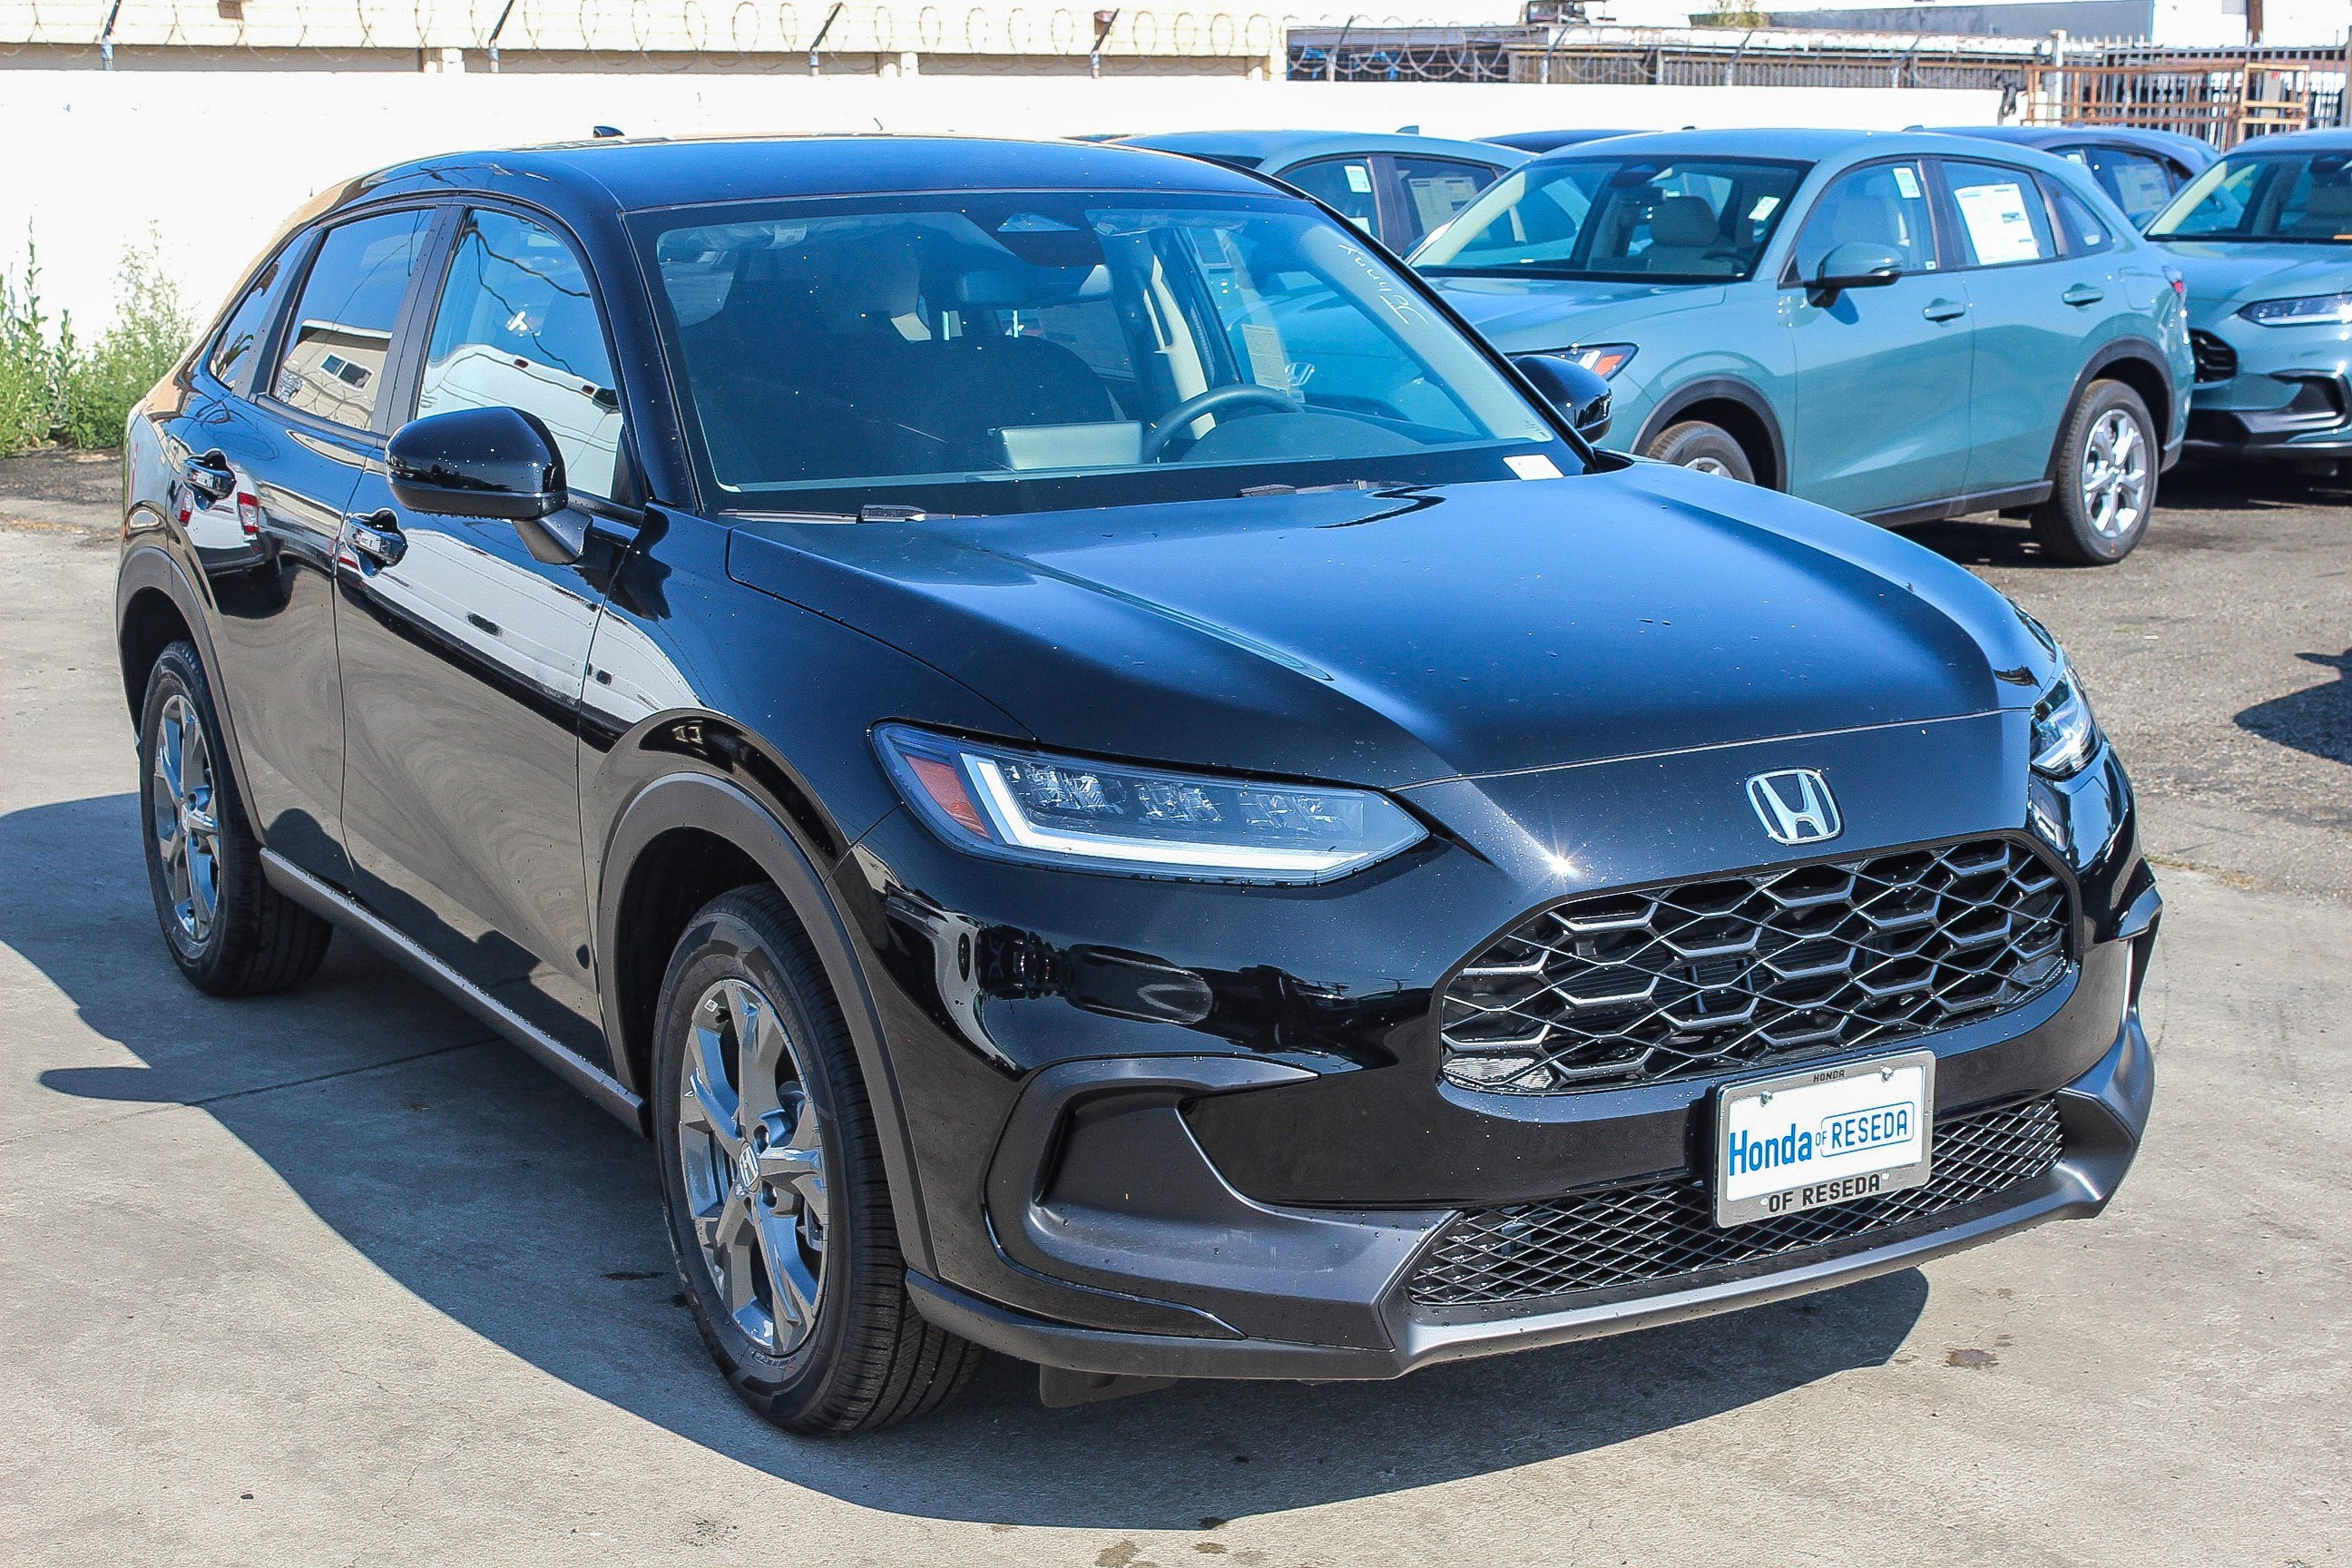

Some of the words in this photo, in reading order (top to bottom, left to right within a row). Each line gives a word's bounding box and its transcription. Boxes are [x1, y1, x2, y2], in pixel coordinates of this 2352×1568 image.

[1812, 1069, 1846, 1083] HONDA
[1730, 1123, 1812, 1176] Honda
[1815, 1131, 1828, 1146] OF
[1832, 1110, 1907, 1149] RESEDA
[1769, 1191, 1794, 1212] OF
[1802, 1173, 1880, 1207] RESEDA
